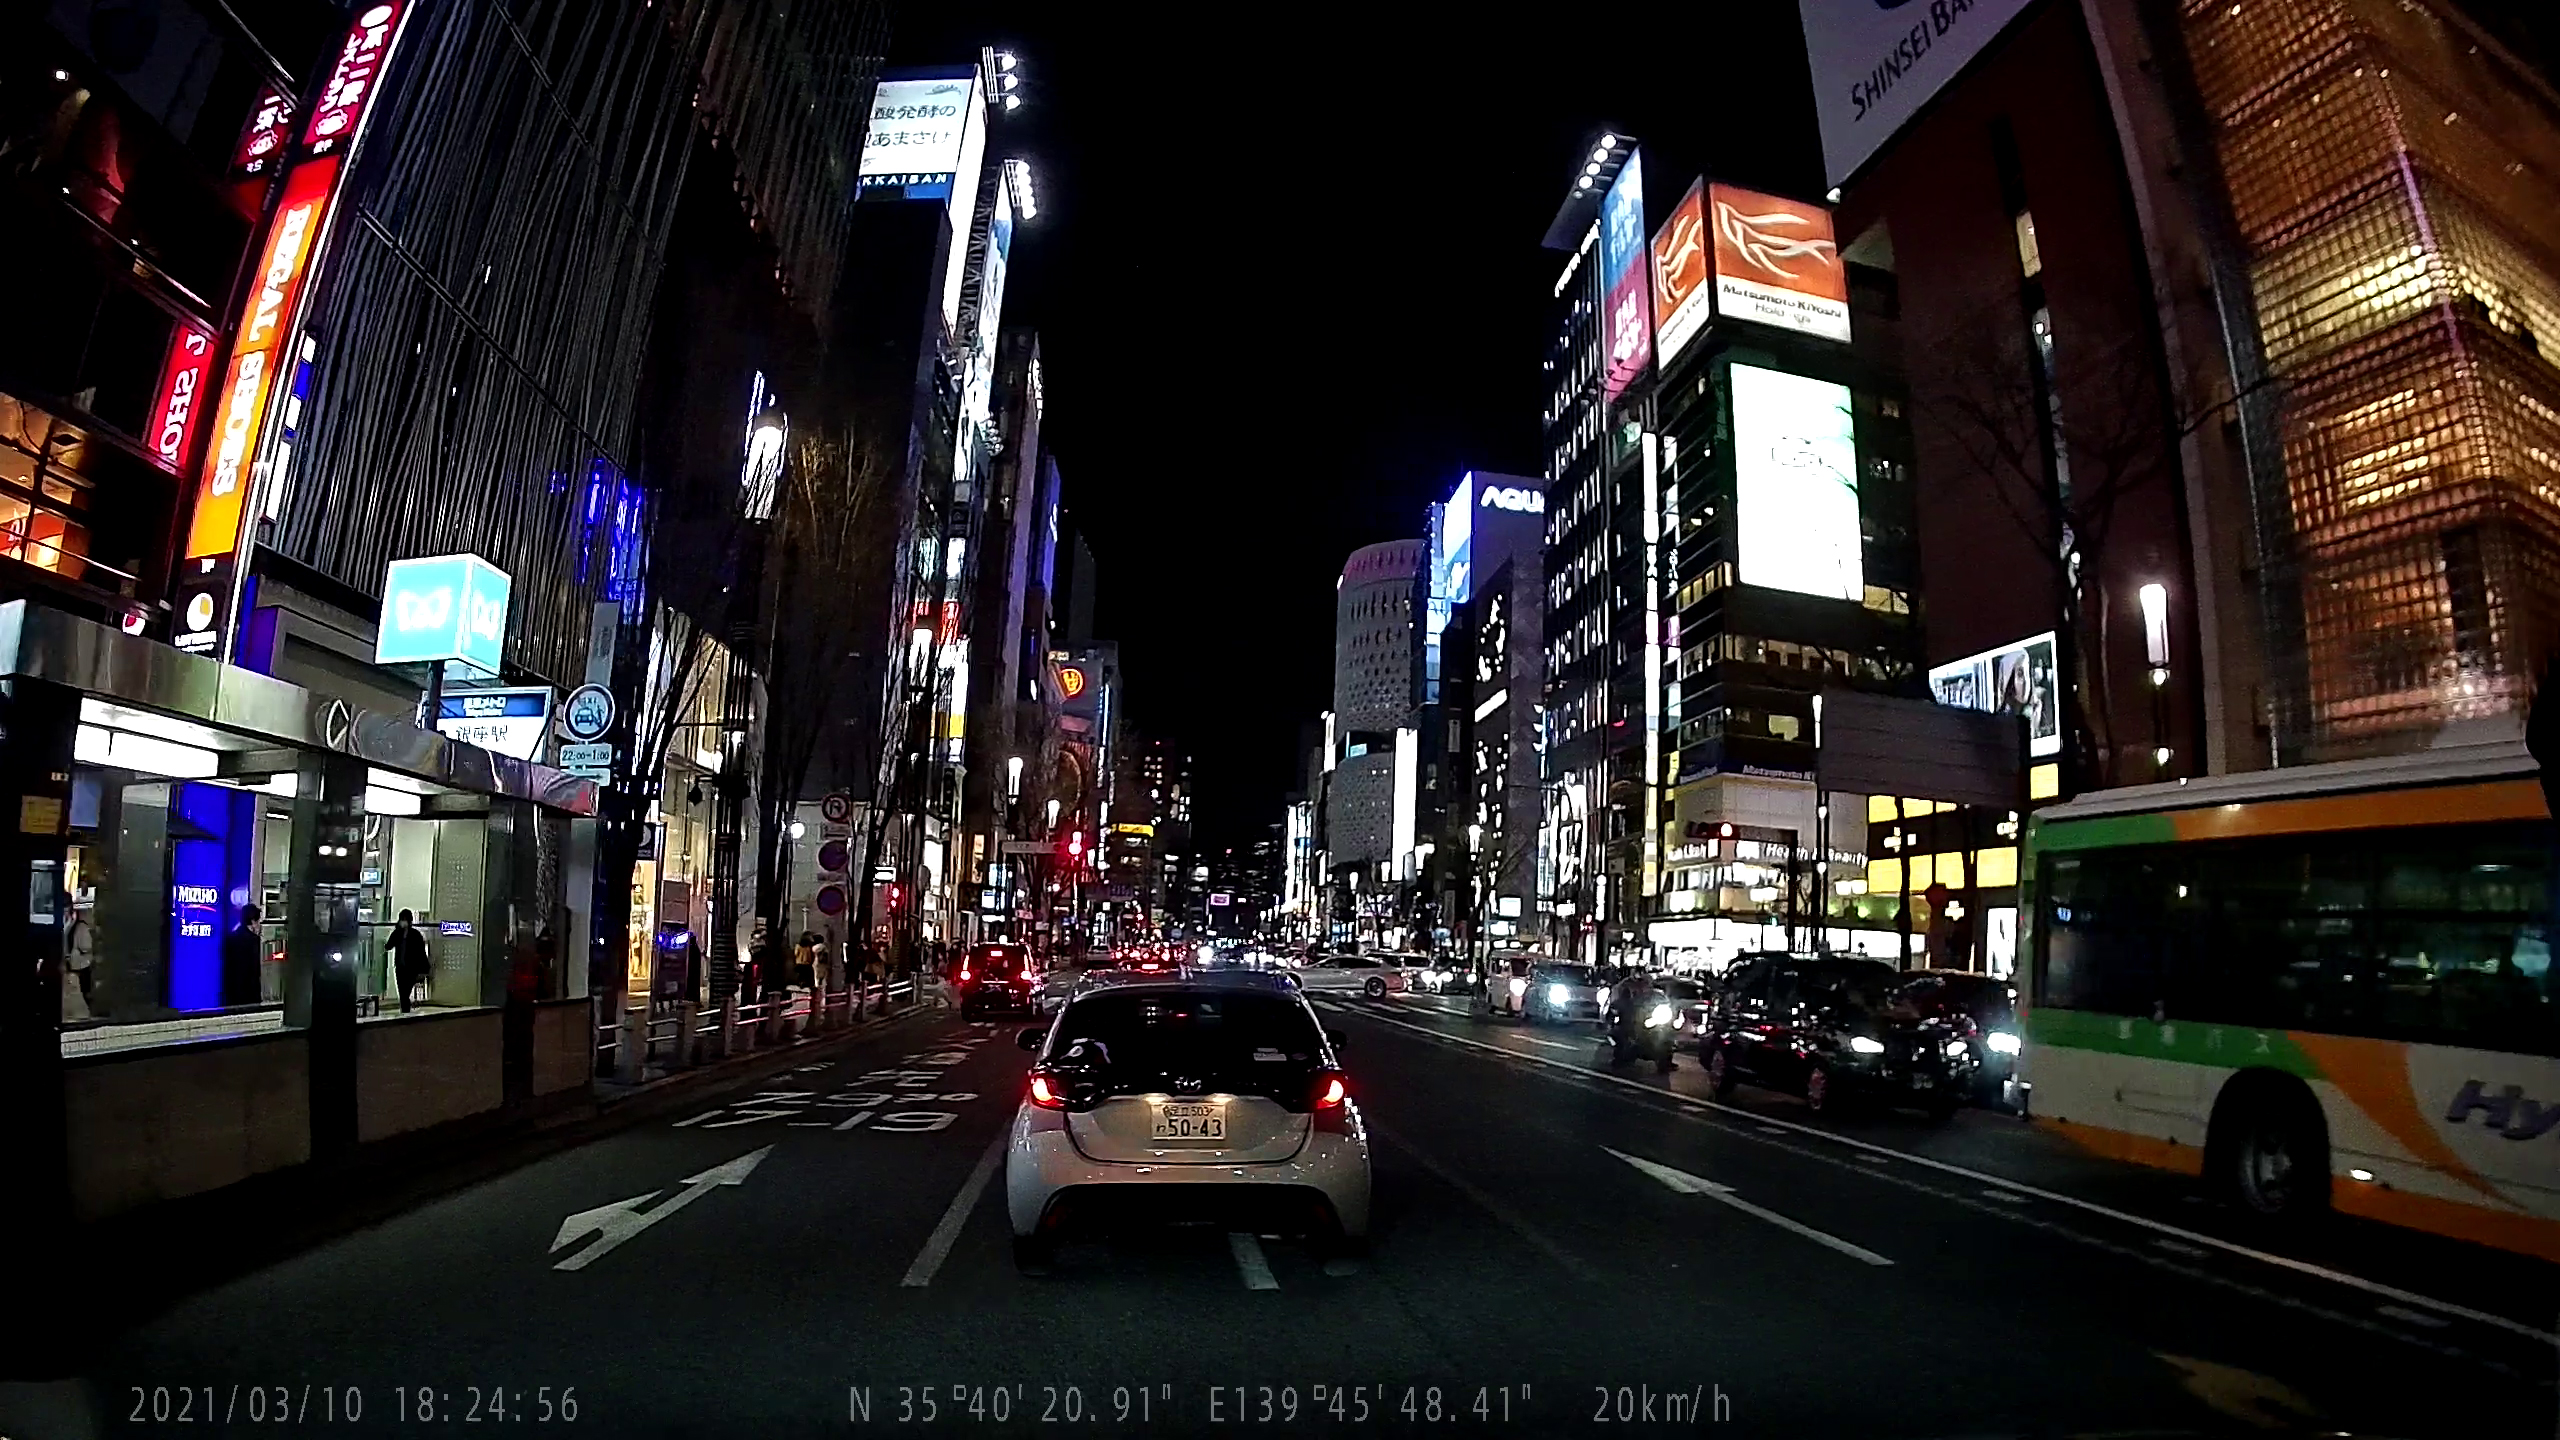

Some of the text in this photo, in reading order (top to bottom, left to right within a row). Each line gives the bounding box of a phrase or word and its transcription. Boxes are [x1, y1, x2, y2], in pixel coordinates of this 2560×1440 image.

[1852, 0, 1974, 122] SHINSEI BA
[870, 105, 956, 120] 酸発酵の
[865, 131, 951, 148] あまさけ
[248, 204, 312, 342] REGAL
[211, 350, 266, 497] SHOES
[1480, 486, 1545, 513] AQU
[178, 885, 217, 904] MIZUHO
[1168, 1119, 1222, 1137] 50-43
